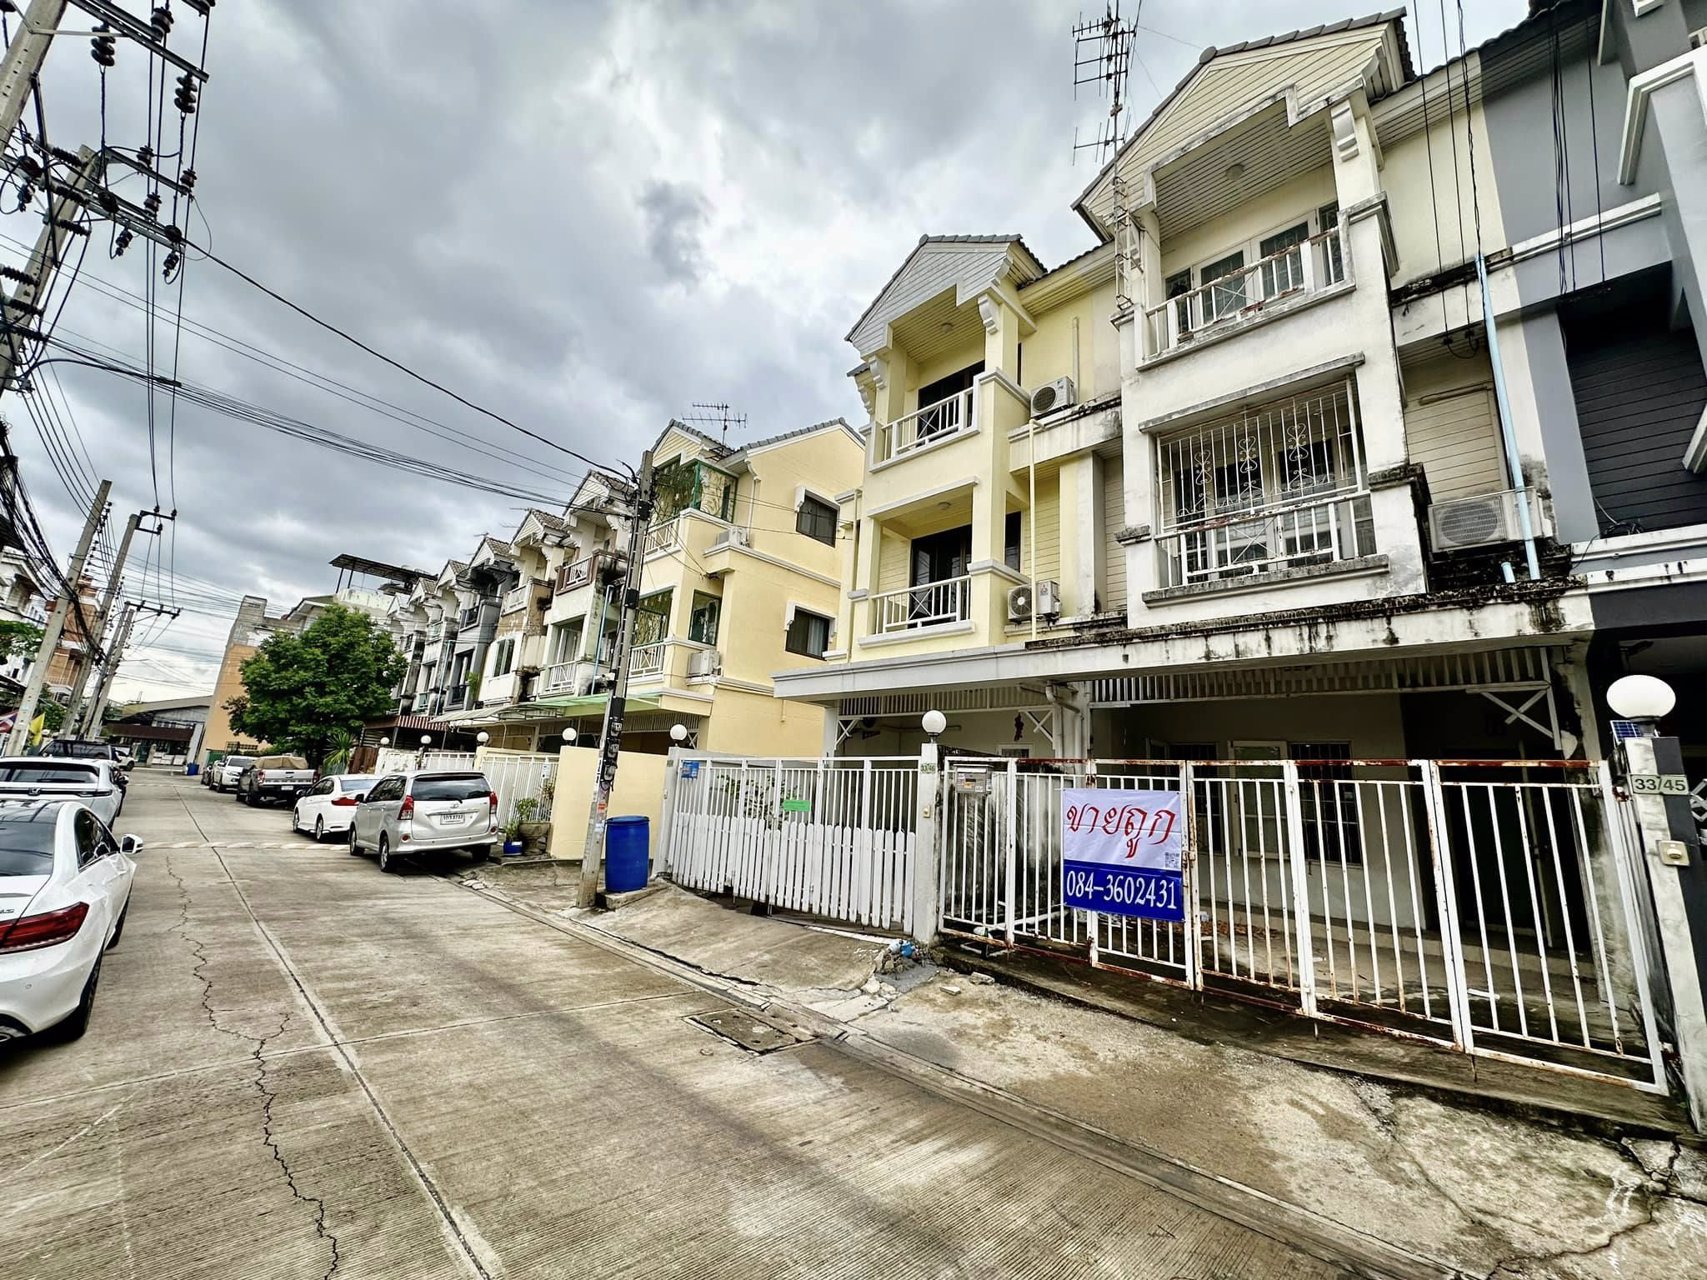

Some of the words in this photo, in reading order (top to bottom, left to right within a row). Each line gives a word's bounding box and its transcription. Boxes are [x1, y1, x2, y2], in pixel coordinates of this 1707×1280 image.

[1634, 778, 1686, 791] 33/45
[1066, 803, 1176, 858] ขายถูก
[1066, 870, 1177, 910] 084-3602431
